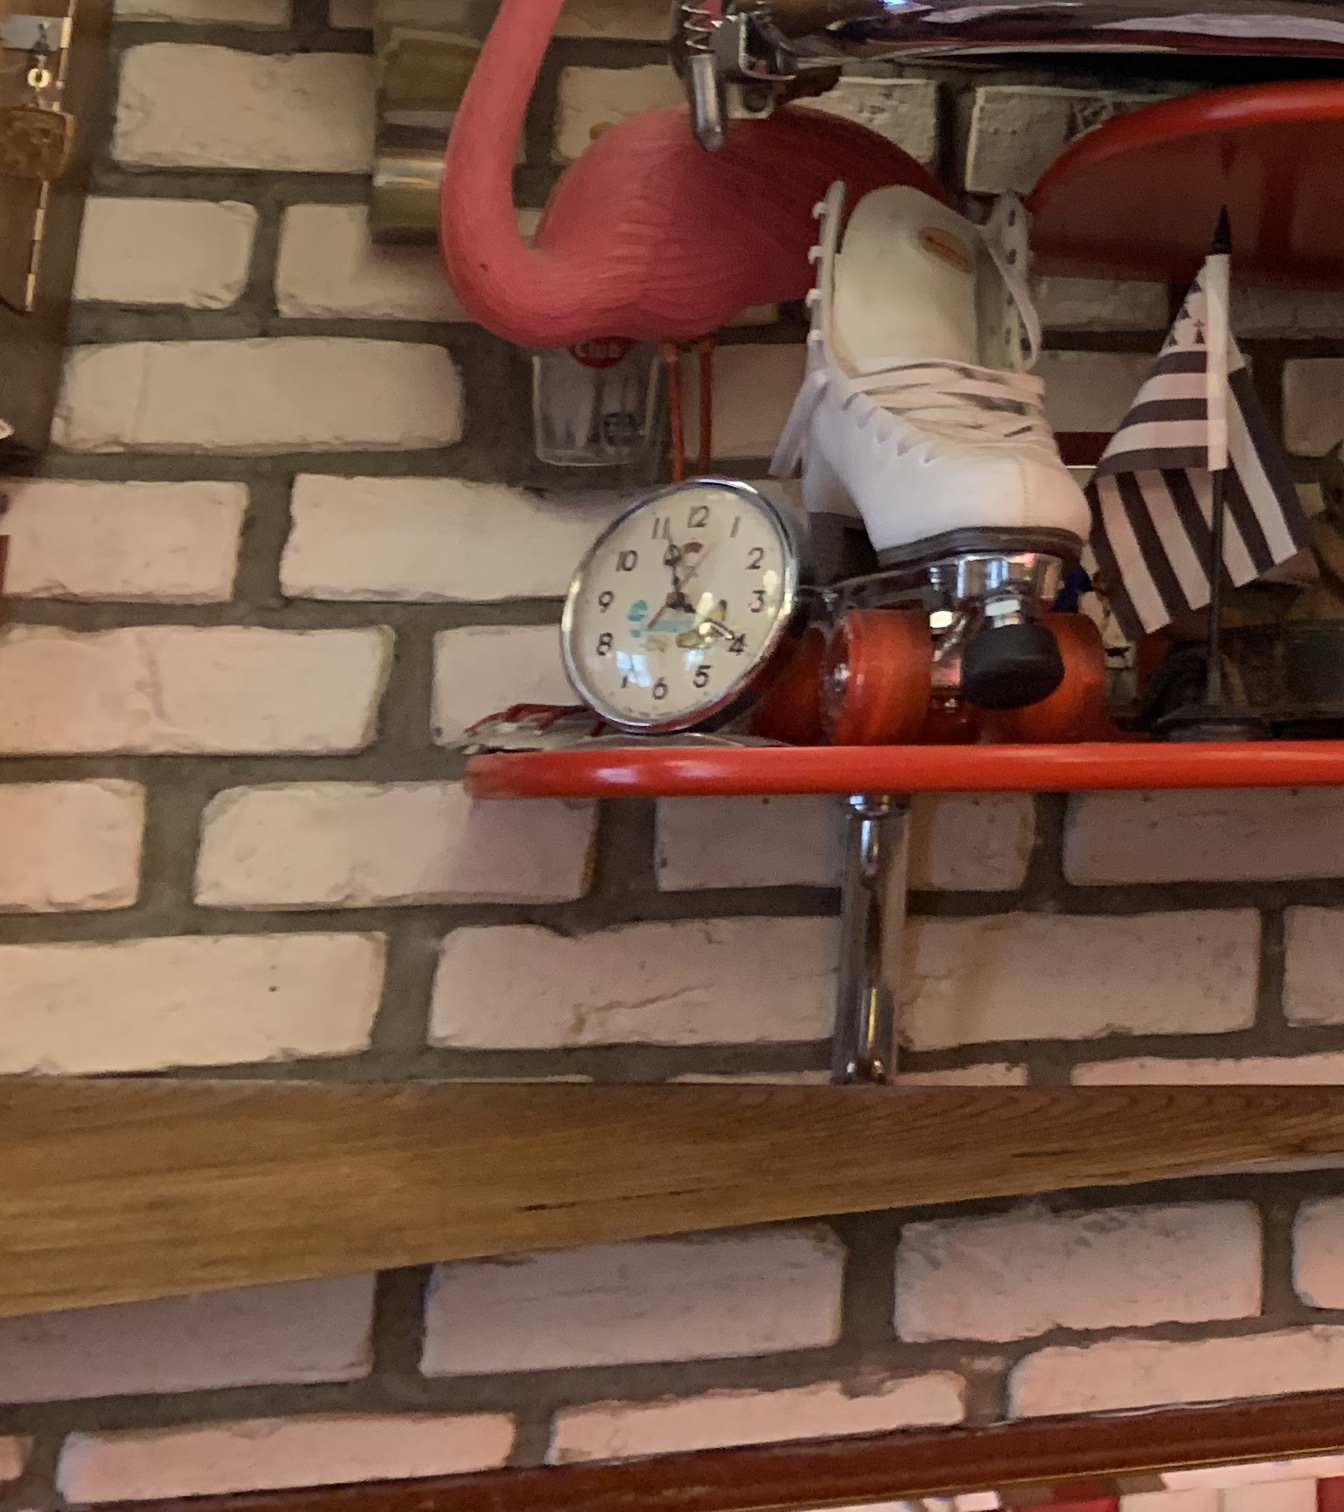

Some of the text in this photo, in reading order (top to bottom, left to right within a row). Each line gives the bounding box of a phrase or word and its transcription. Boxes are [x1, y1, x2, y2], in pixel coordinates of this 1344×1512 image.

[650, 517, 671, 539] 11
[687, 505, 710, 528] 12
[730, 516, 741, 538] 1
[615, 550, 638, 572] 10
[745, 546, 765, 570] 2
[598, 590, 614, 614] 9
[747, 589, 765, 613] 3
[596, 632, 613, 656] 8
[692, 665, 711, 688] 5
[652, 677, 668, 700] 6
